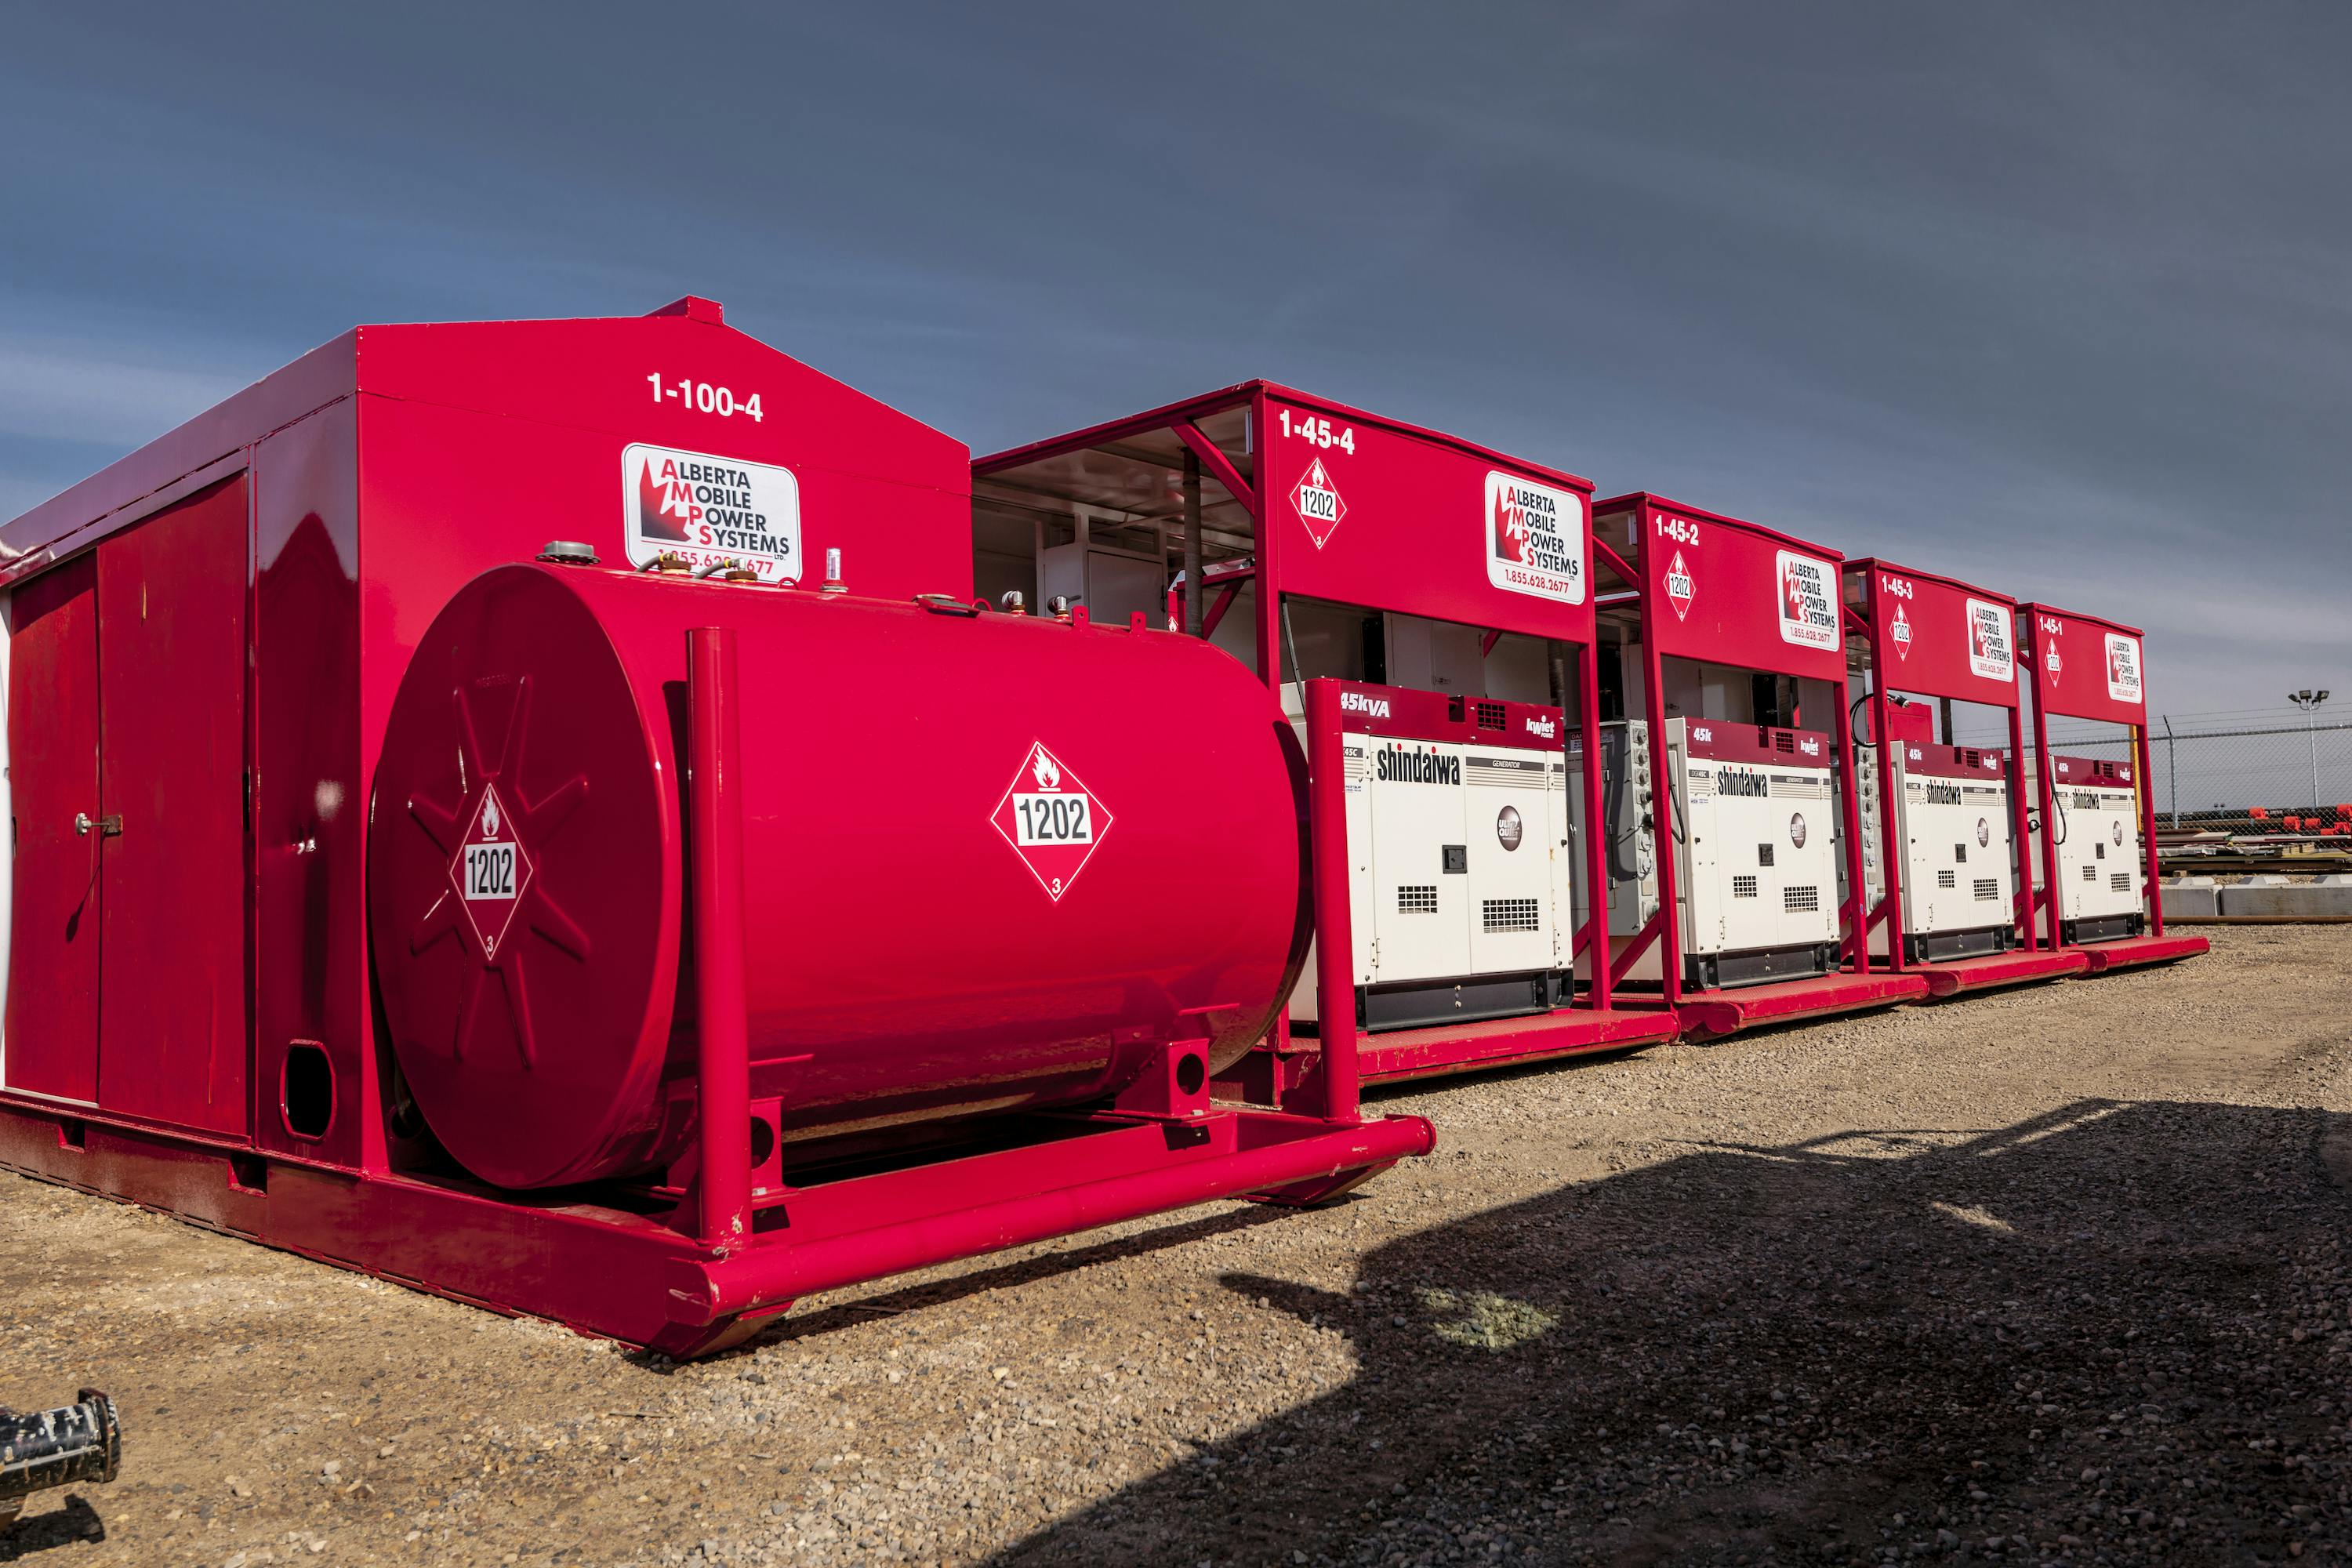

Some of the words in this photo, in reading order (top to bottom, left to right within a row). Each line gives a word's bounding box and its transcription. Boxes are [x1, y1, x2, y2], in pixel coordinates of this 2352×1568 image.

[647, 372, 764, 423] 1-100-4
[1279, 409, 1355, 456] 1-45-4
[661, 459, 751, 490] ALBERTA
[671, 481, 752, 510] MOBILE
[1302, 488, 1334, 518] 1202
[1507, 486, 1555, 515] ALBERTA
[688, 505, 767, 532] POWER
[1512, 506, 1555, 534] MOBILE
[699, 525, 790, 555] SYSTEMS
[1316, 535, 1322, 546] 3
[1656, 515, 1699, 546] 1-45-2
[1522, 529, 1565, 554] POWER
[1527, 548, 1578, 575] SYSTEMS
[1789, 561, 1820, 581] ALBERTA
[1505, 569, 1569, 593] 1.855.628.2677
[1671, 576, 1689, 597] 1202
[1792, 577, 1820, 596] MOBILE
[1882, 575, 1913, 600] 1-45-3
[1799, 594, 1828, 613] POWER
[1804, 608, 1835, 629] SYSTEMS
[1976, 607, 1998, 623] ALBERTA
[2039, 615, 2063, 636] 1-45-1
[1790, 626, 1830, 643] 1.855.628.2677
[1895, 625, 1908, 641] 1202
[1978, 620, 1999, 636] MOBILE
[1984, 634, 2004, 649] POWER
[2112, 641, 2130, 652] ALBERTA
[1987, 646, 2010, 663] SYSTEMS
[2114, 652, 2130, 664] MOBILE
[2118, 664, 2133, 675] POWER
[2121, 674, 2139, 687] SYSTEMS
[1341, 692, 1390, 718] 45kVA
[1526, 715, 1555, 735] kwiet
[1693, 728, 1711, 742] 45k
[1343, 747, 1358, 757] 45C
[1909, 748, 1922, 760] 45k
[1377, 742, 1461, 786] shindaiwa
[1492, 760, 1520, 769] GENERATOR
[1718, 765, 1767, 797] shindaiwa
[1926, 779, 1961, 805] shindaiwa
[1019, 798, 1087, 840] 1202
[468, 848, 512, 894] 1202
[1051, 877, 1061, 894] 3
[487, 935, 494, 952] 3
